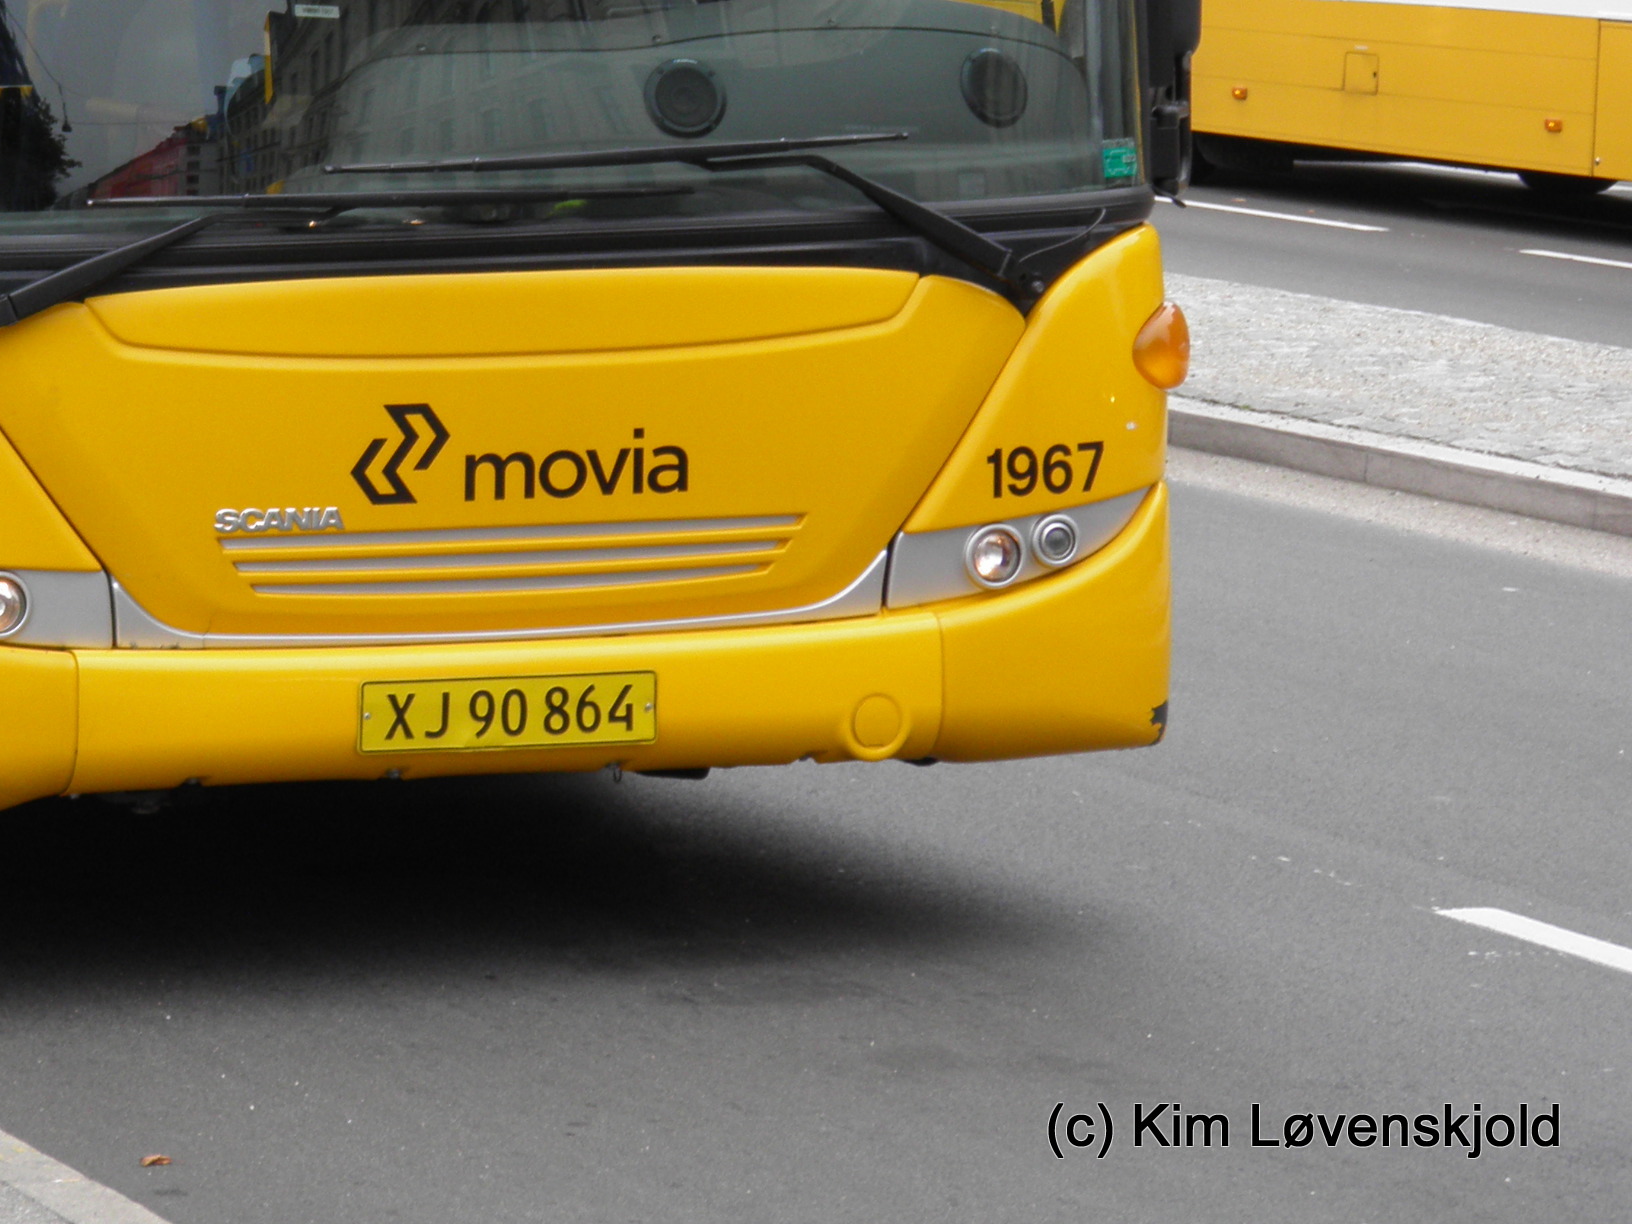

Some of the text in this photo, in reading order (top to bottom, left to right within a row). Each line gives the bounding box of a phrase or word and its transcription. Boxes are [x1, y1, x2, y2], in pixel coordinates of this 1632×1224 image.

[464, 428, 688, 502] movia
[986, 441, 1105, 499] 1967
[214, 507, 345, 532] SCANIA
[385, 684, 635, 740] XJ 90 864
